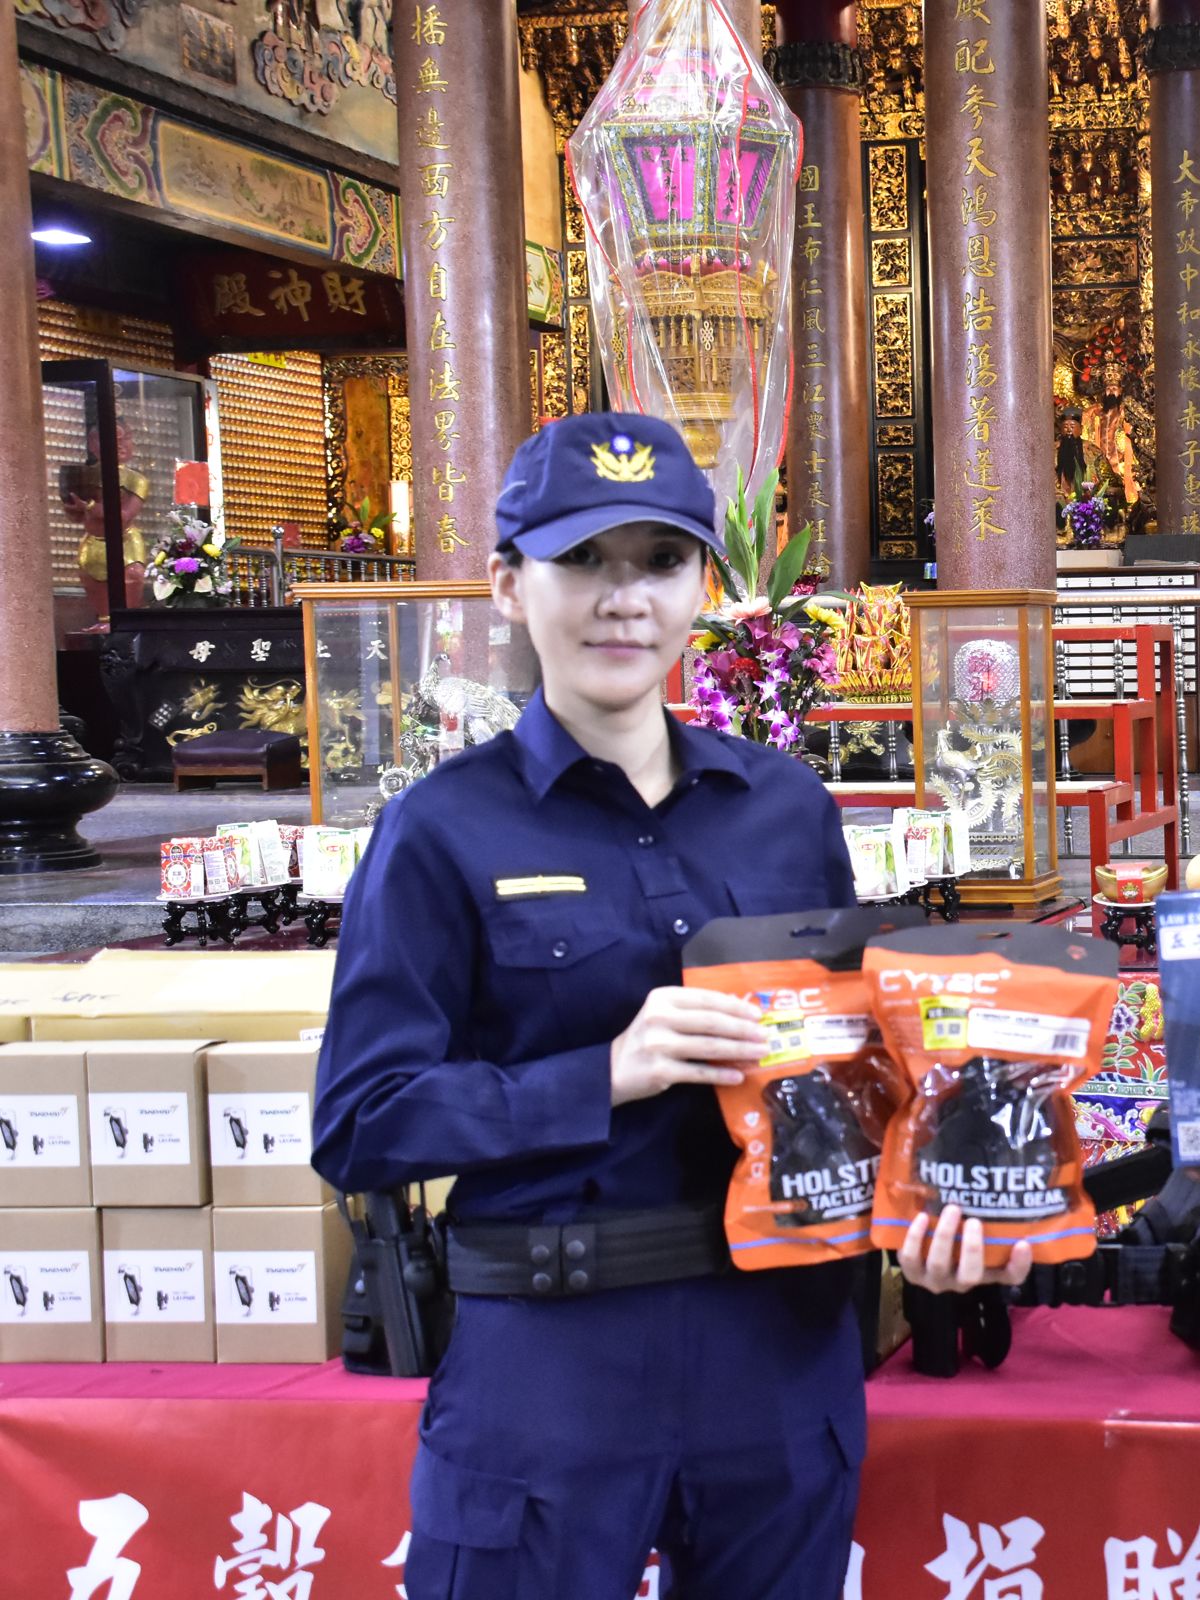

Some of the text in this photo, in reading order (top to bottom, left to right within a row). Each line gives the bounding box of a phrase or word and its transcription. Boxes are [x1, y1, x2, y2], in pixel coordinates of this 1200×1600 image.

[189, 639, 388, 662] 天上聖母
[1160, 914, 1184, 925] LAW
[920, 1160, 1046, 1190] HOLSTER
[940, 1188, 1065, 1208] TACTICAL GEAR
